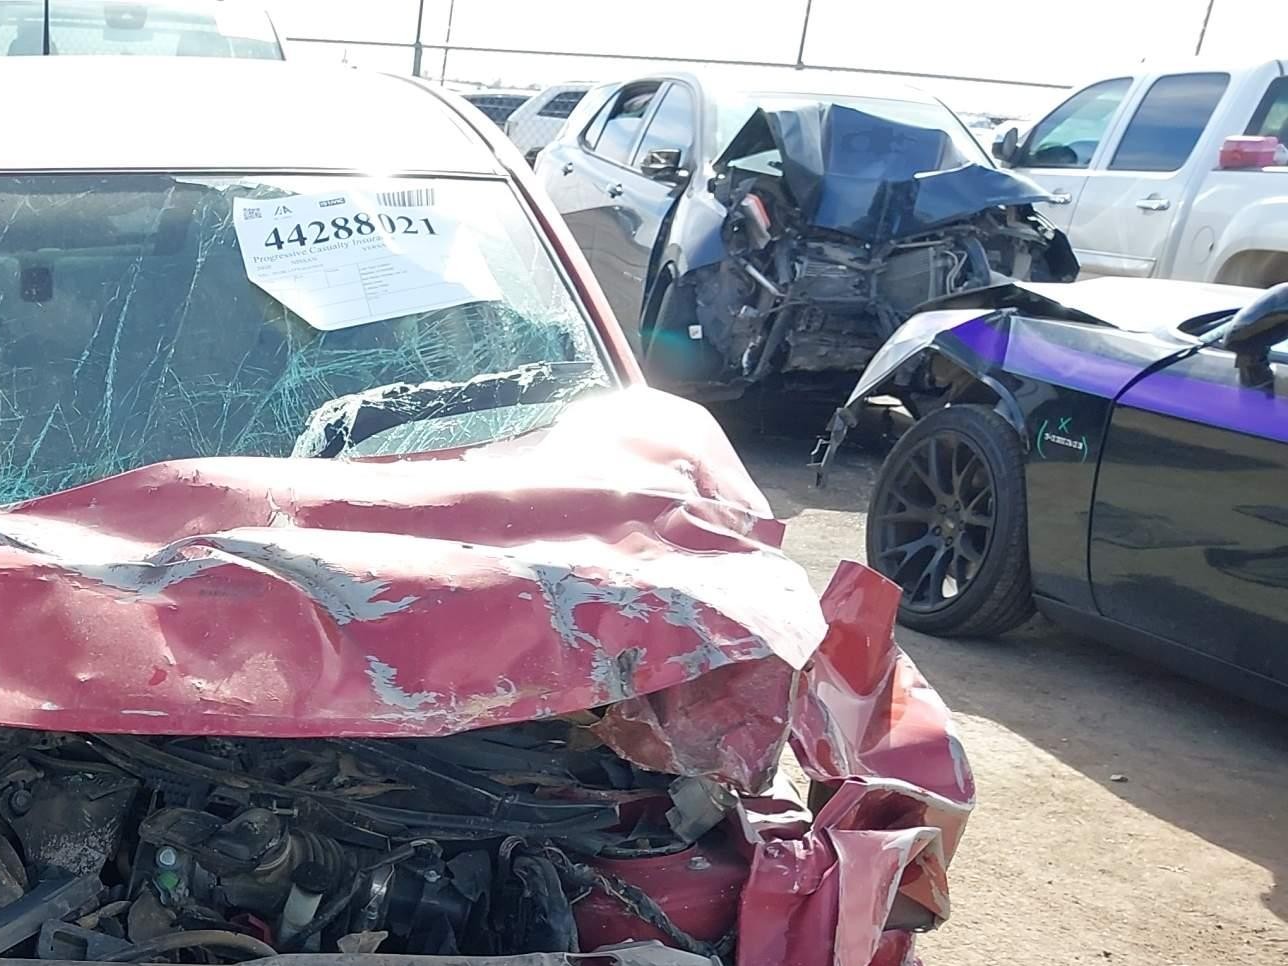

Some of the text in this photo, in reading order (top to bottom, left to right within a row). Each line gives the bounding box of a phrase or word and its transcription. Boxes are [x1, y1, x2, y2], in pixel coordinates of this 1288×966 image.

[264, 212, 440, 251] 44288021
[252, 248, 307, 264] Progressive
[309, 240, 350, 256] Casualty
